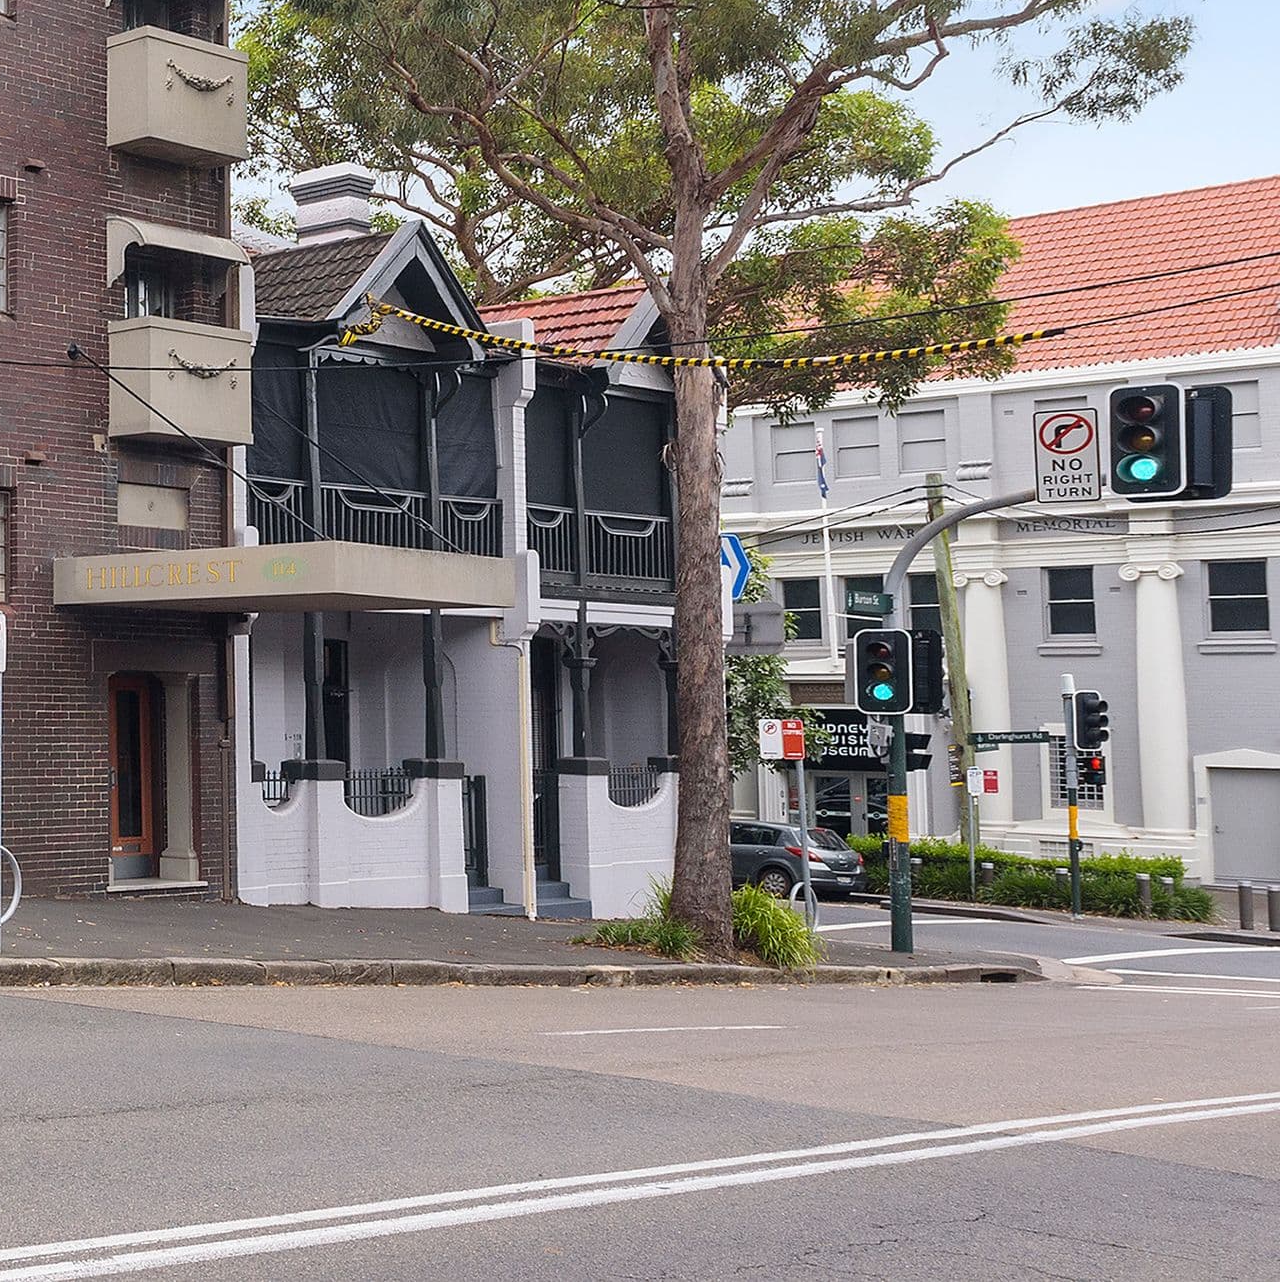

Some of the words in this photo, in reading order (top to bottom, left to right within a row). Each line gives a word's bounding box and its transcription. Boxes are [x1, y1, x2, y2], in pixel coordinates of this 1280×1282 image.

[1052, 458, 1082, 471] NO
[1043, 473, 1093, 485] RIGHT
[1046, 487, 1092, 498] TURN
[1016, 518, 1116, 533] MEMORIAL
[877, 528, 915, 540] WAR
[86, 559, 243, 590] HILLCREST
[988, 732, 1031, 741] Darlinghurst
